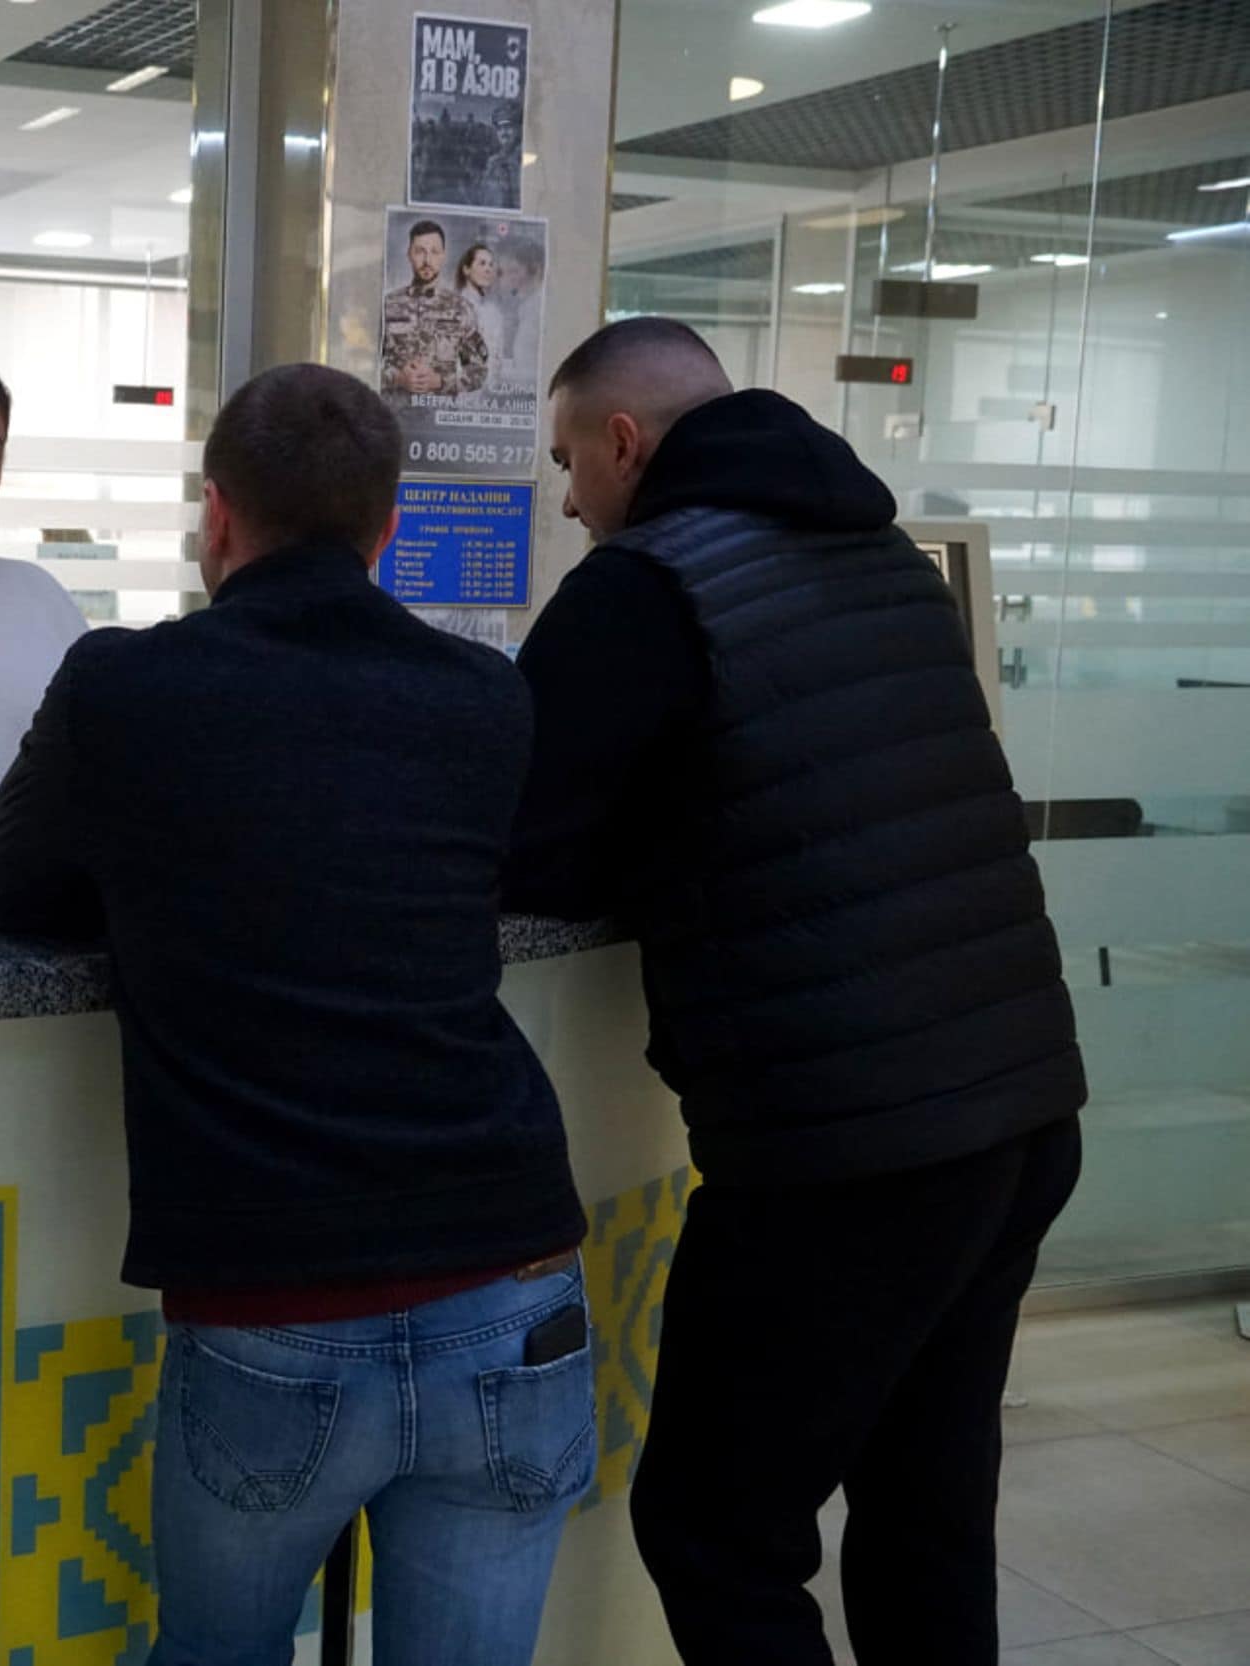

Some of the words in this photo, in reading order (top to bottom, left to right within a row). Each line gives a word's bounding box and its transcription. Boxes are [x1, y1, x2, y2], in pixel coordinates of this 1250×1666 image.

[422, 24, 481, 63] МАМ,
[420, 58, 436, 91] Я
[442, 59, 458, 92] В
[462, 63, 520, 99] АЗОВ
[409, 441, 422, 460] 0
[426, 442, 460, 461] 800
[464, 444, 497, 463] 505
[502, 445, 535, 464] 217
[405, 489, 447, 502] ЦЕНТР
